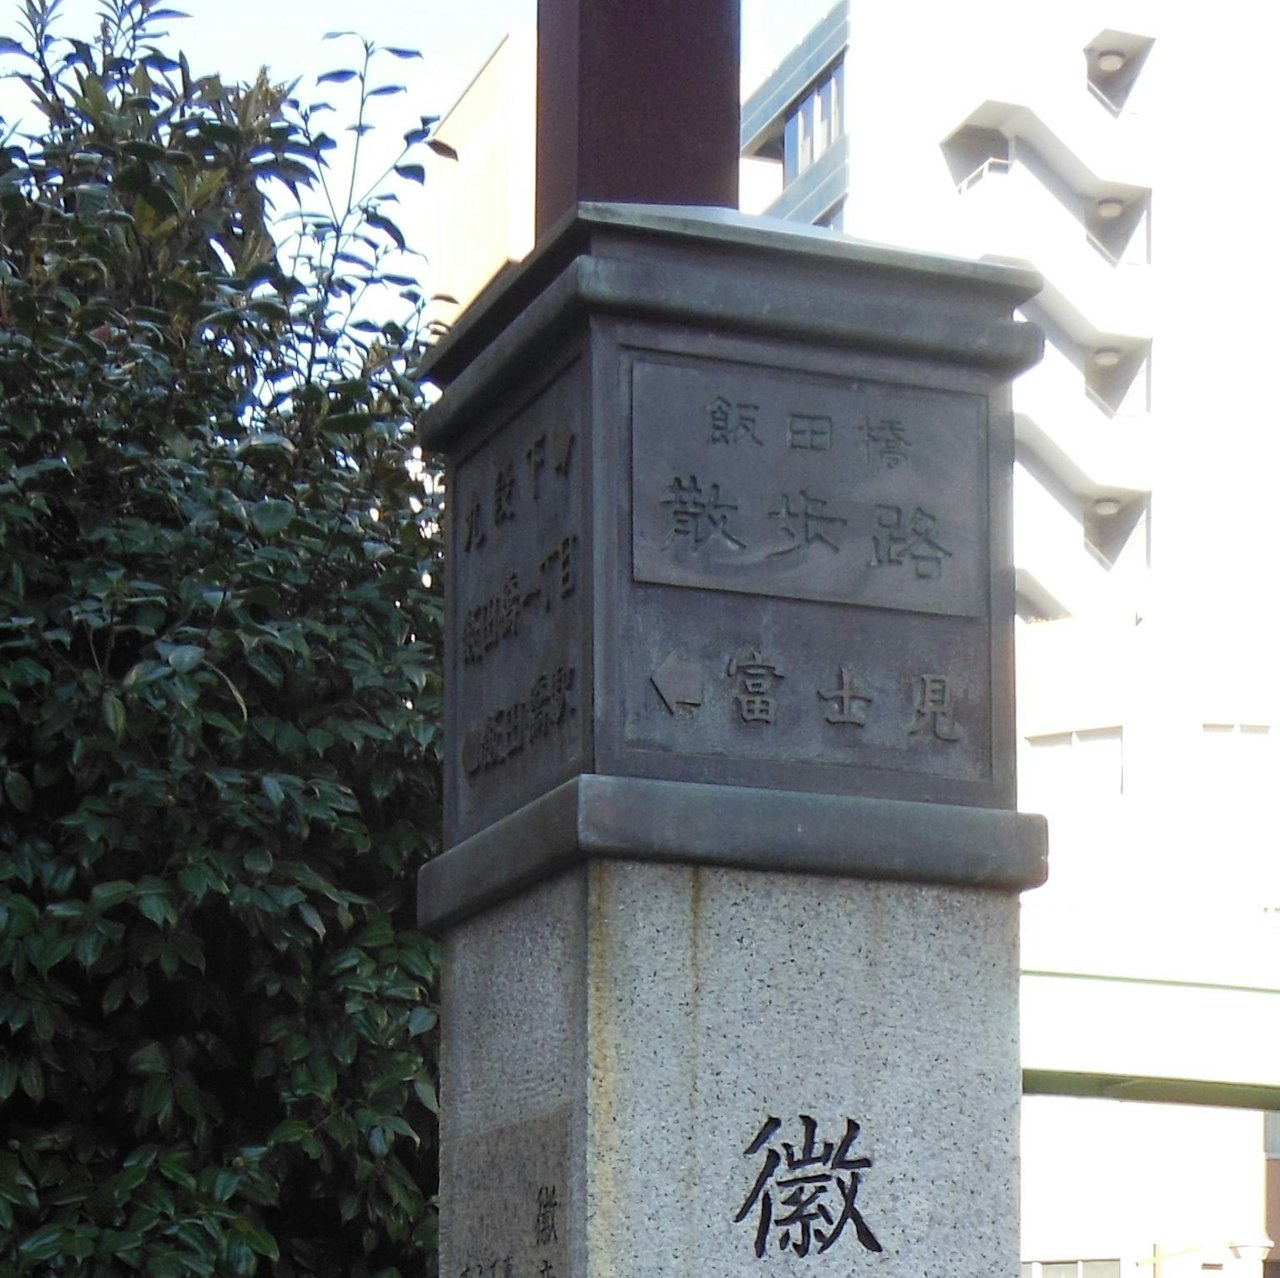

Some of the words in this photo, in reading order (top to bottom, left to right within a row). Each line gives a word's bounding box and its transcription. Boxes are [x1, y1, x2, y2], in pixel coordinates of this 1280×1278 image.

[705, 395, 912, 470] 飯田橋
[464, 432, 548, 554] 九段下
[660, 475, 952, 580] 散歩路
[724, 651, 961, 743] 富士見
